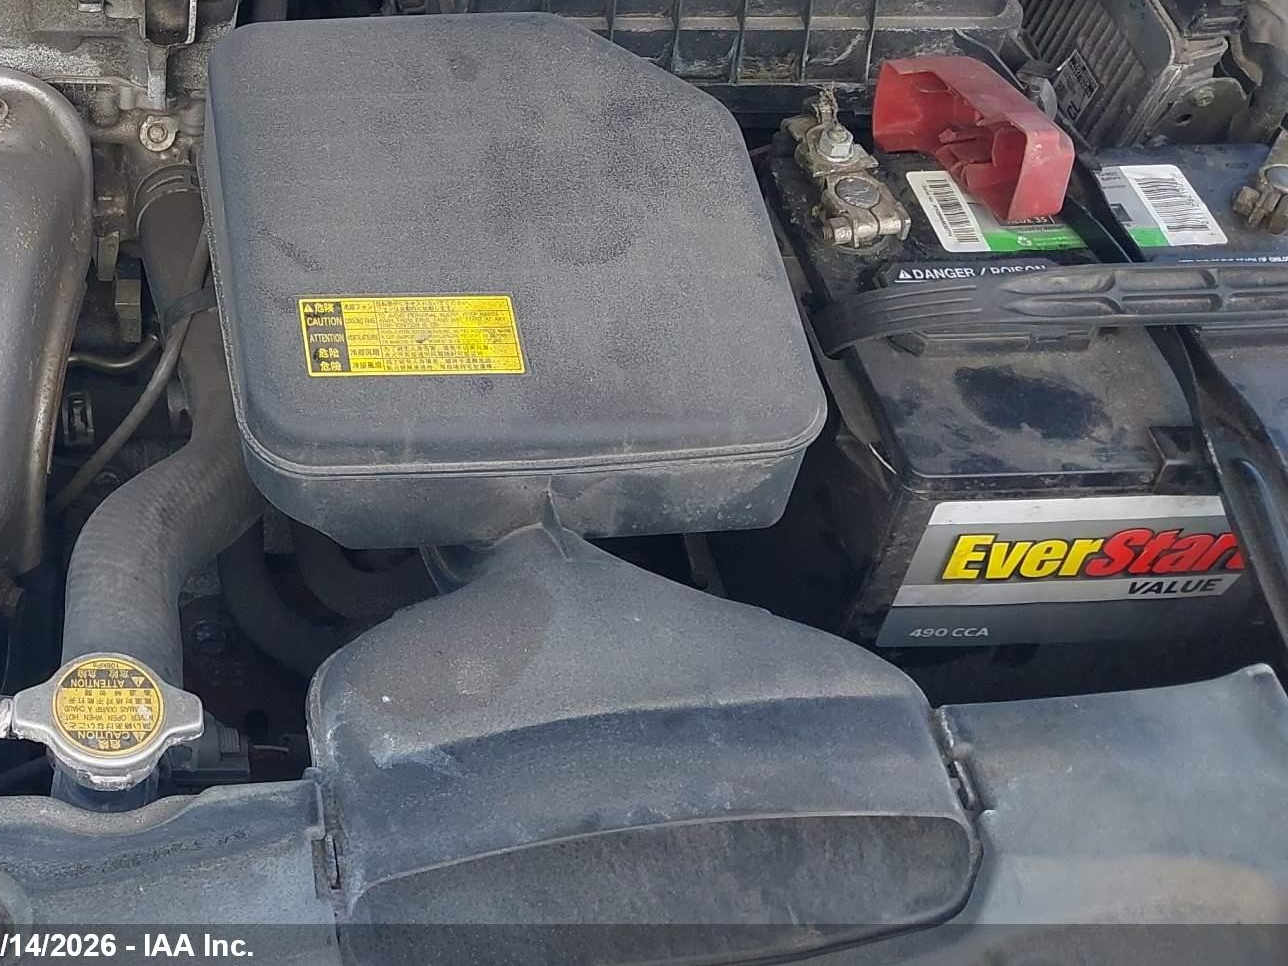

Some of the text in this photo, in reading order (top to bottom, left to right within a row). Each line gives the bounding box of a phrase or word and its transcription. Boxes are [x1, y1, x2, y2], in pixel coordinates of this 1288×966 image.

[912, 267, 976, 279] DANGER
[306, 316, 343, 327] CAUTION
[309, 333, 345, 344] ATTENTION
[941, 528, 1246, 580] EverStar
[1128, 577, 1223, 596] VALUE
[909, 627, 989, 638] 490 CCA
[70, 679, 125, 688] ATTENTION
[78, 731, 130, 739] CAUTION
